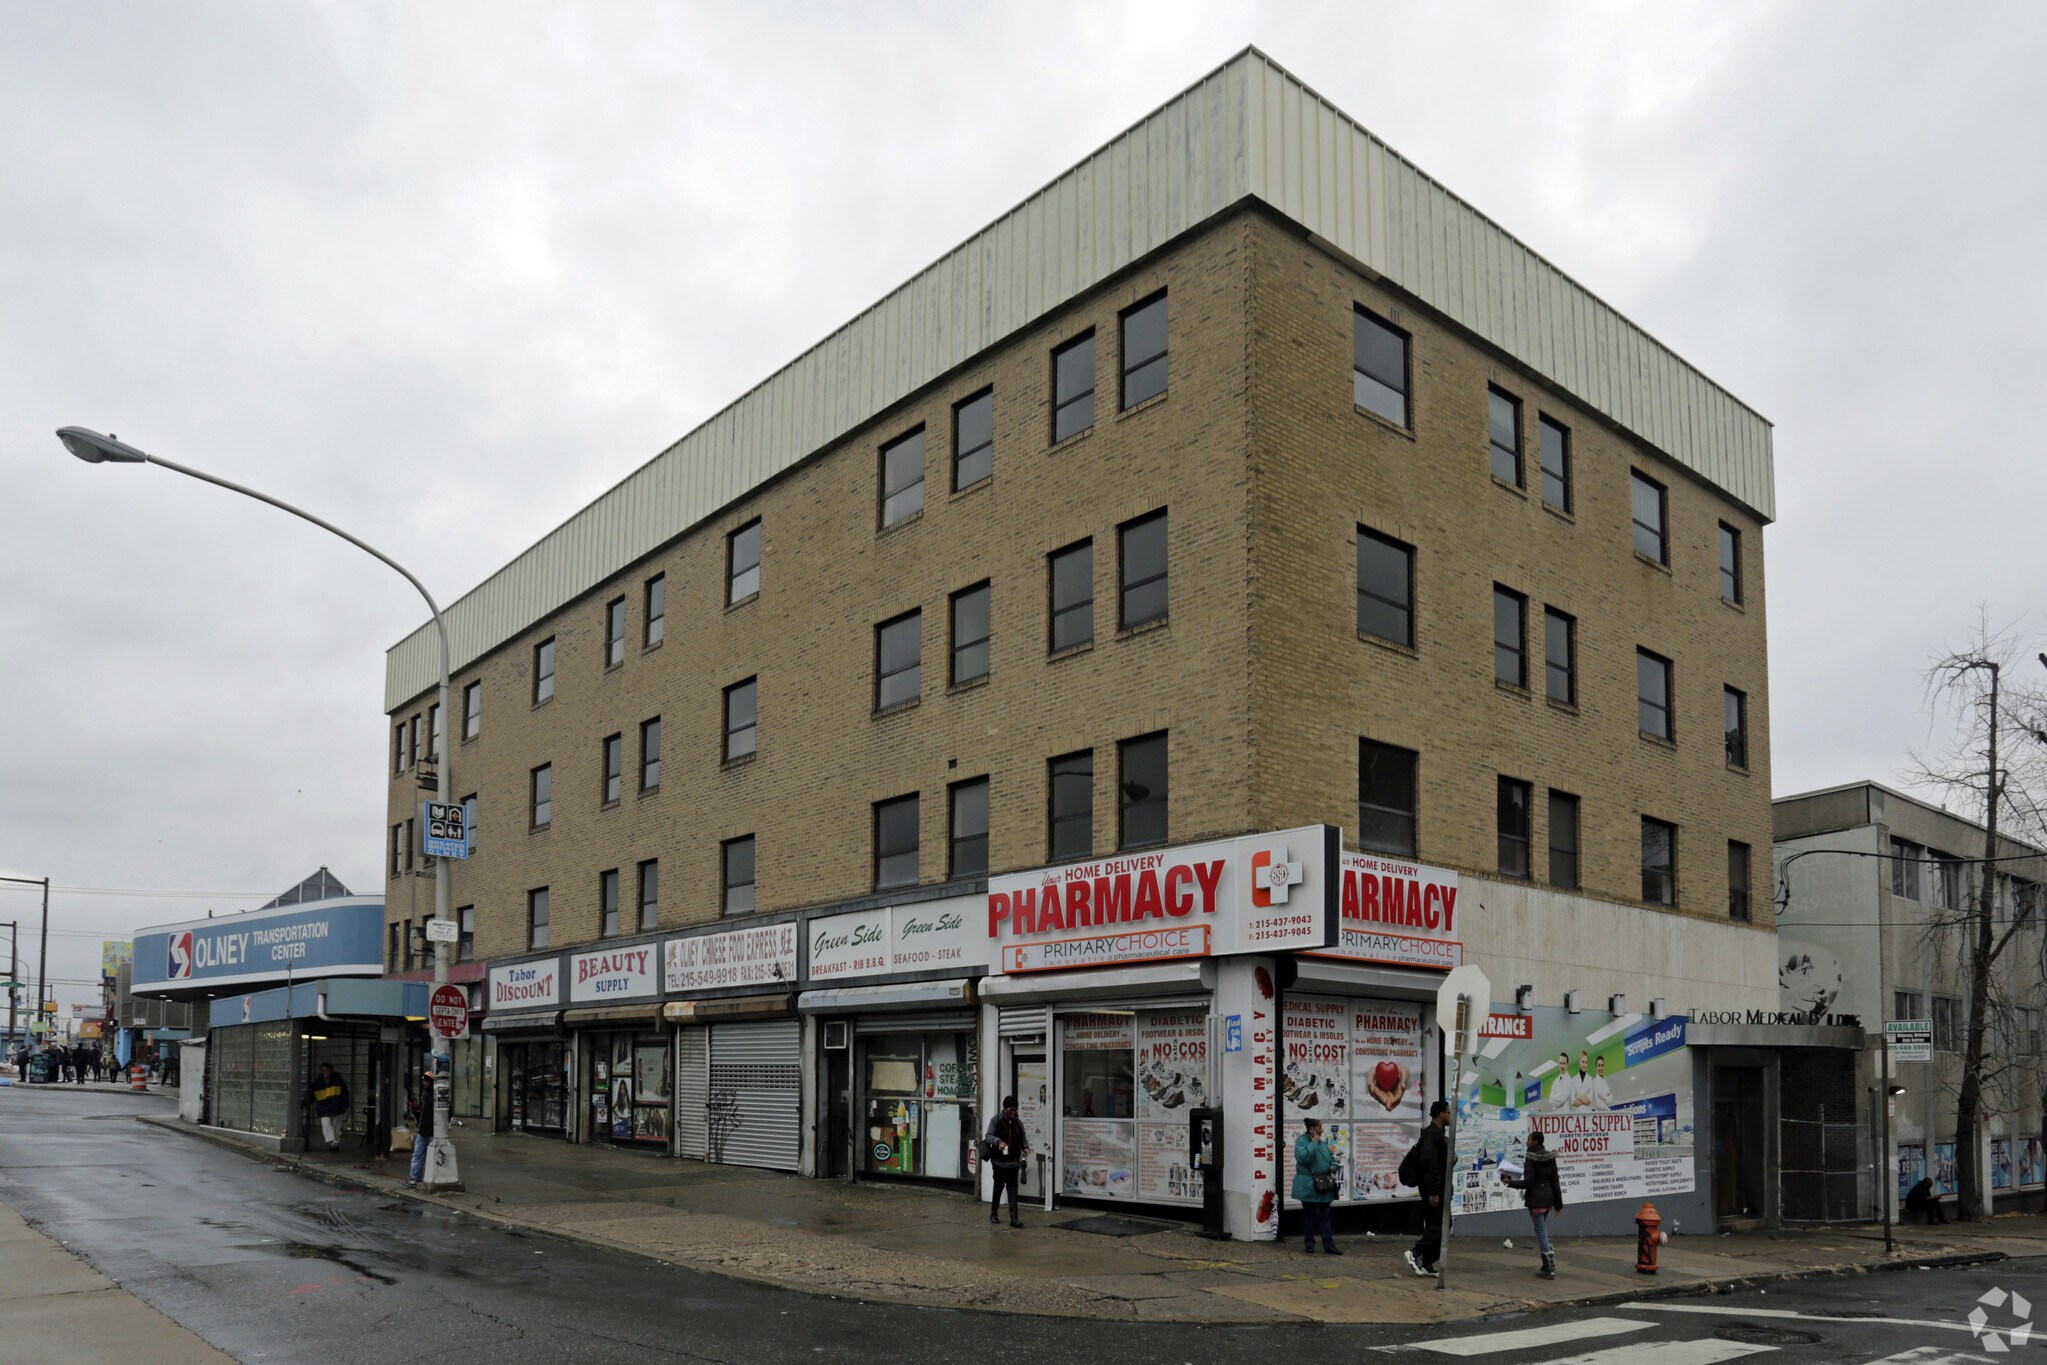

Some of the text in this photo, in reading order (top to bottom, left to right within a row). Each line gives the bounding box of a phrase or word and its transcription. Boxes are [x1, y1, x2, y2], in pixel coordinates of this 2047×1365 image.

[1065, 864, 1100, 881] HOME
[1104, 854, 1164, 874] DELIVERY
[1352, 857, 1378, 871] HOME
[1381, 862, 1418, 877] DELIVERY
[988, 859, 1226, 938] PHARMACY
[1342, 869, 1457, 931] ARMACY
[901, 912, 963, 940] Green Side
[1256, 915, 1312, 929] 215-437-9043
[814, 923, 883, 959] Green Side
[1256, 927, 1312, 940] 215-437-9045
[195, 921, 328, 968] OLNEY TRANSPORTATION
[271, 942, 306, 961] CENTER
[680, 940, 700, 968] OLNEY
[702, 936, 727, 966] CHINESE
[729, 933, 744, 962] FOOD
[746, 929, 777, 961] EXPRESS
[893, 951, 930, 965] SEAFOOD
[937, 947, 961, 960] STEAK
[1114, 949, 1170, 961] pharmaceutical
[578, 950, 649, 984] BEAUTY
[812, 961, 847, 976] BREAKFAST
[853, 958, 864, 970] RIB
[866, 956, 886, 969] B.B.Q.
[508, 969, 536, 982] Tabor
[495, 973, 553, 1003] DISCOUNT
[595, 977, 629, 993] SUPPLY
[435, 994, 462, 1004] DO NOT
[436, 1006, 450, 1014] SEPTA
[1315, 1002, 1345, 1014] SUPPLY
[438, 1018, 460, 1028] ENTE
[1150, 1015, 1203, 1027] DIABETIC
[1287, 1016, 1335, 1029] DIABETIC
[1355, 1014, 1418, 1031] PHARMACY
[1688, 1008, 1742, 1025] TABOR
[1746, 1009, 1804, 1025] MEDICAL
[1077, 1031, 1092, 1039] HOME
[1093, 1030, 1120, 1038] DELIVERY
[1141, 1030, 1177, 1039] FOOTWEAR
[1178, 1029, 1183, 1037] &
[1887, 1022, 1929, 1032] AVAILABLE
[1313, 1031, 1318, 1039] &
[1319, 1031, 1345, 1041] INSOLES
[1366, 1036, 1382, 1044] HOME
[1383, 1037, 1408, 1046] DEVERY
[1627, 1023, 1682, 1056] Scripts Ready
[1064, 1040, 1133, 1050] CONSULTING PHARMACY
[1153, 1042, 1172, 1057] NO
[1289, 1042, 1347, 1060] NO COST
[1355, 1048, 1418, 1058] CONSULTING PHARMACY
[1253, 1010, 1266, 1180] PHARMACY
[1266, 1028, 1274, 1162] MEDICAL SUPPLY
[1531, 1114, 1633, 1134] MEDICAL SUPPLY
[1564, 1138, 1579, 1152] NO
[1582, 1137, 1609, 1152] COST
